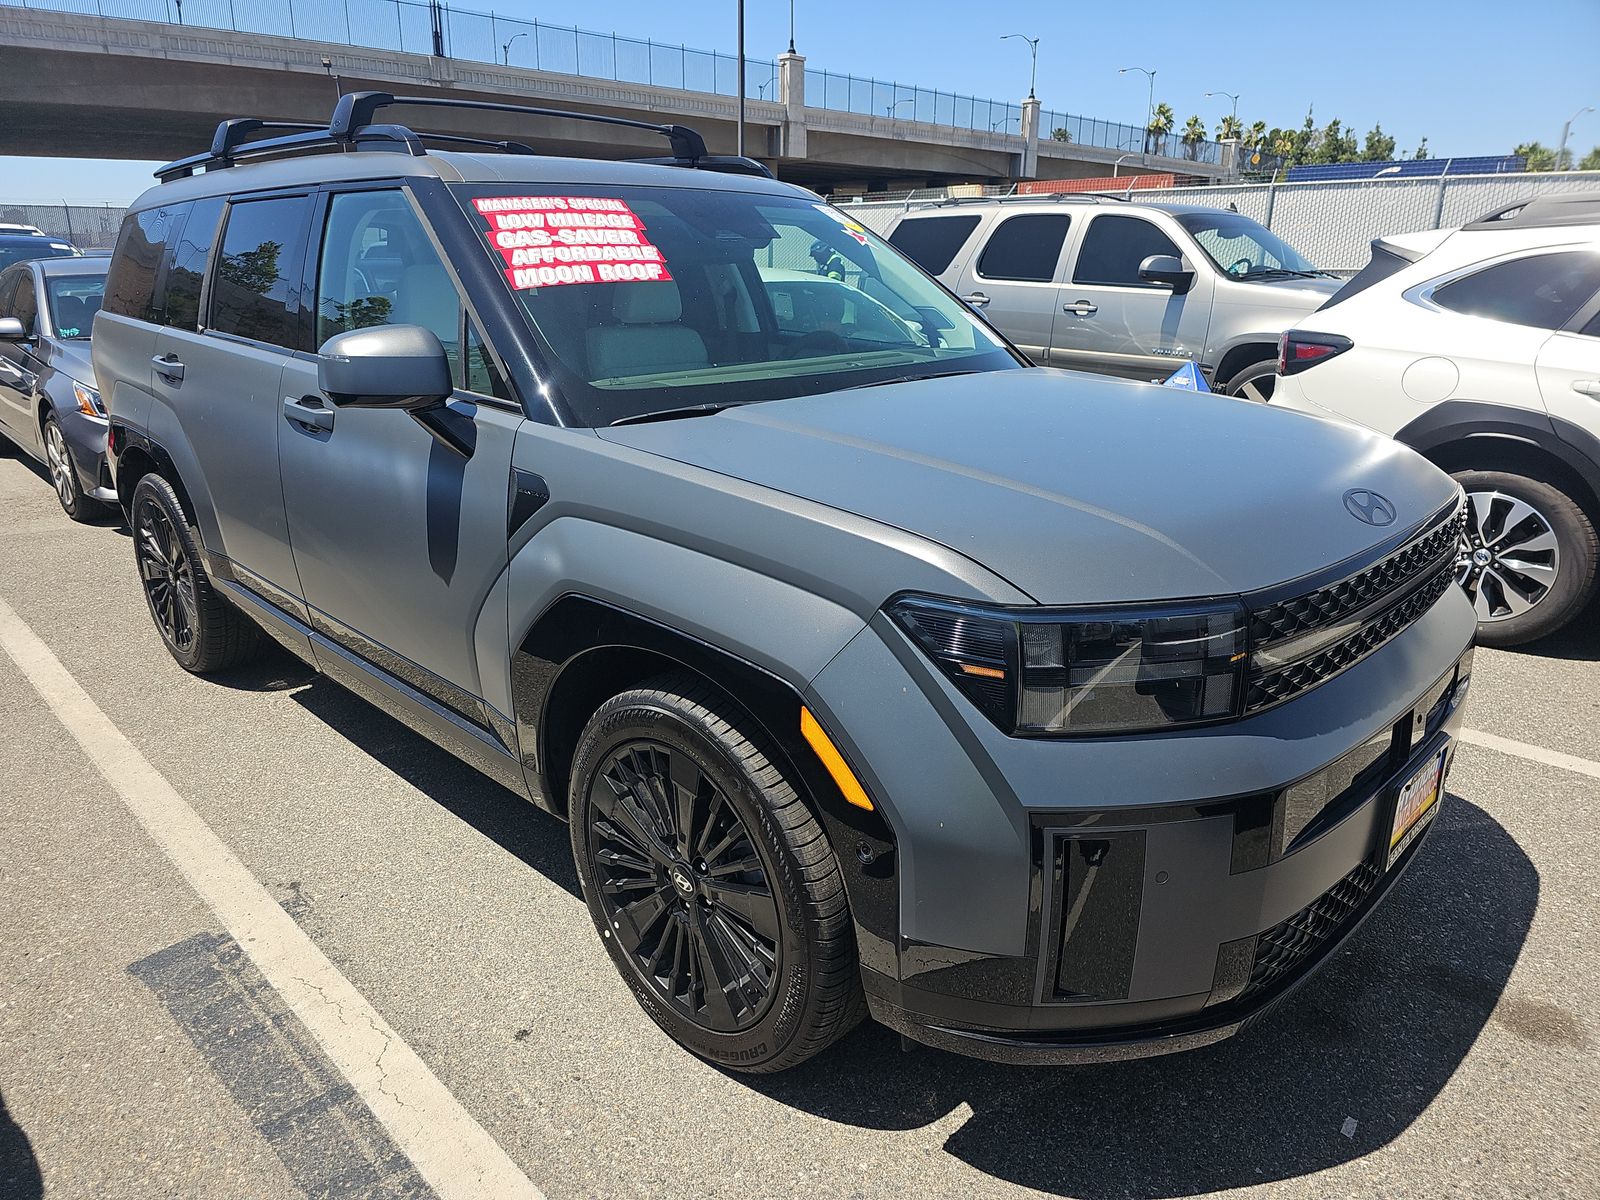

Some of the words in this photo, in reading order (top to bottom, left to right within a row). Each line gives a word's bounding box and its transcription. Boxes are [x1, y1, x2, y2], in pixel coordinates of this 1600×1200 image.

[477, 197, 568, 212] MANAGER'S
[568, 198, 628, 212] SPECIAL
[496, 213, 544, 229] LOW
[546, 212, 636, 228] MILEAGE
[496, 228, 641, 248] GAS-SAVER
[511, 245, 660, 265] AFFORDABLE
[513, 265, 594, 288] MOON
[597, 263, 662, 281] ROOF
